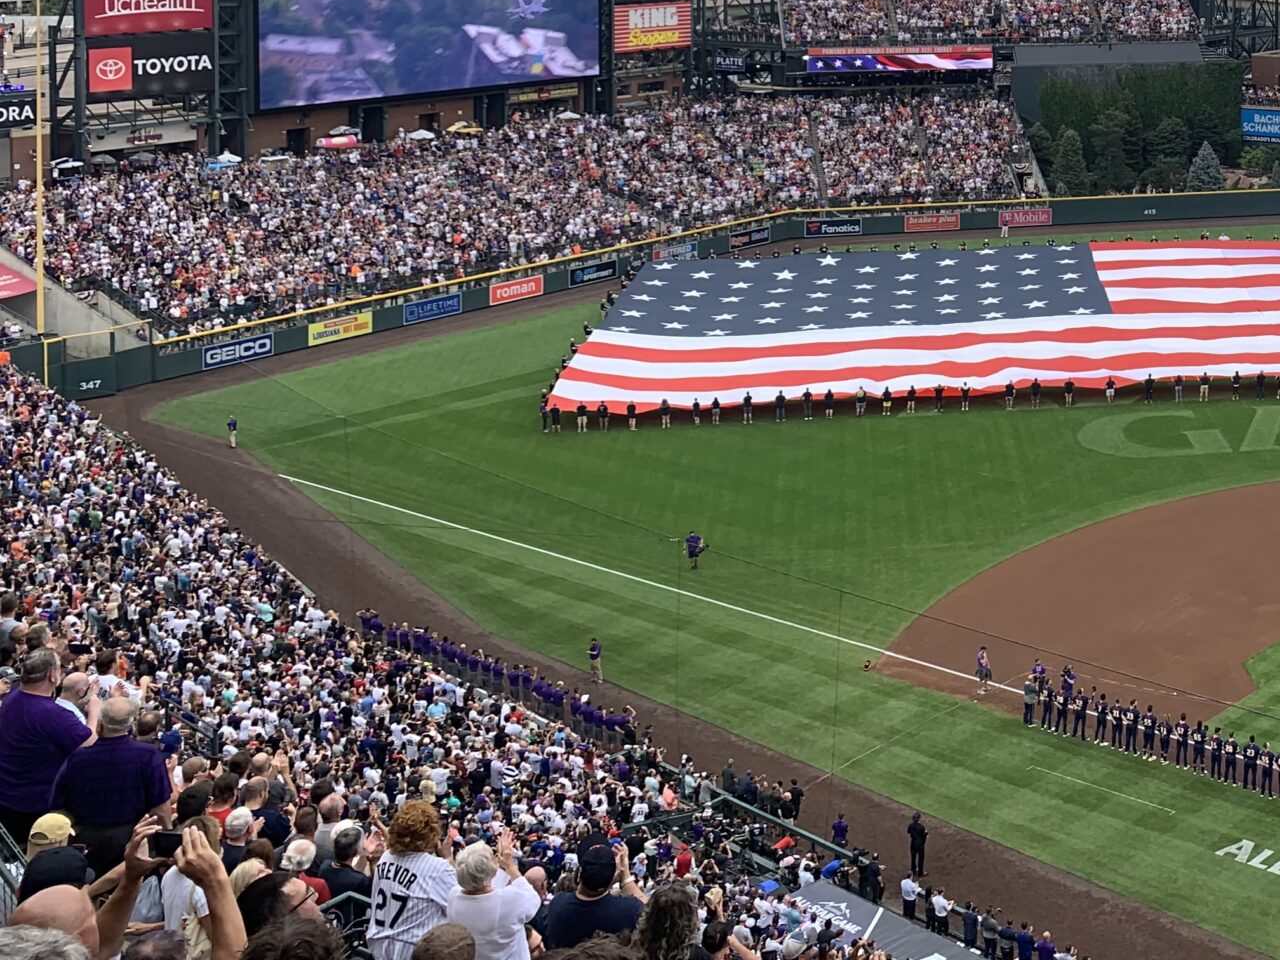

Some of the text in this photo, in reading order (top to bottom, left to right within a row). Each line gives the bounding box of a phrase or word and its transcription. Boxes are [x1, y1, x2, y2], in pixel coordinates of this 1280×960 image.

[628, 6, 679, 28] KING
[134, 54, 212, 76] TOYOTA
[716, 56, 743, 66] PLATTE
[909, 215, 957, 224] brakes plus
[1013, 211, 1048, 223] Mobile
[1143, 208, 1156, 216] 415
[821, 223, 860, 233] Fanatics
[660, 245, 692, 258] BETFRED
[496, 281, 536, 299] roman
[418, 297, 460, 314] LIFETIME
[312, 327, 341, 341] LOUISIANA
[205, 337, 271, 365] GEICO
[79, 379, 102, 391] 347
[376, 862, 418, 891] TREVOR
[374, 887, 409, 930] 27
[832, 916, 862, 934] GAME
